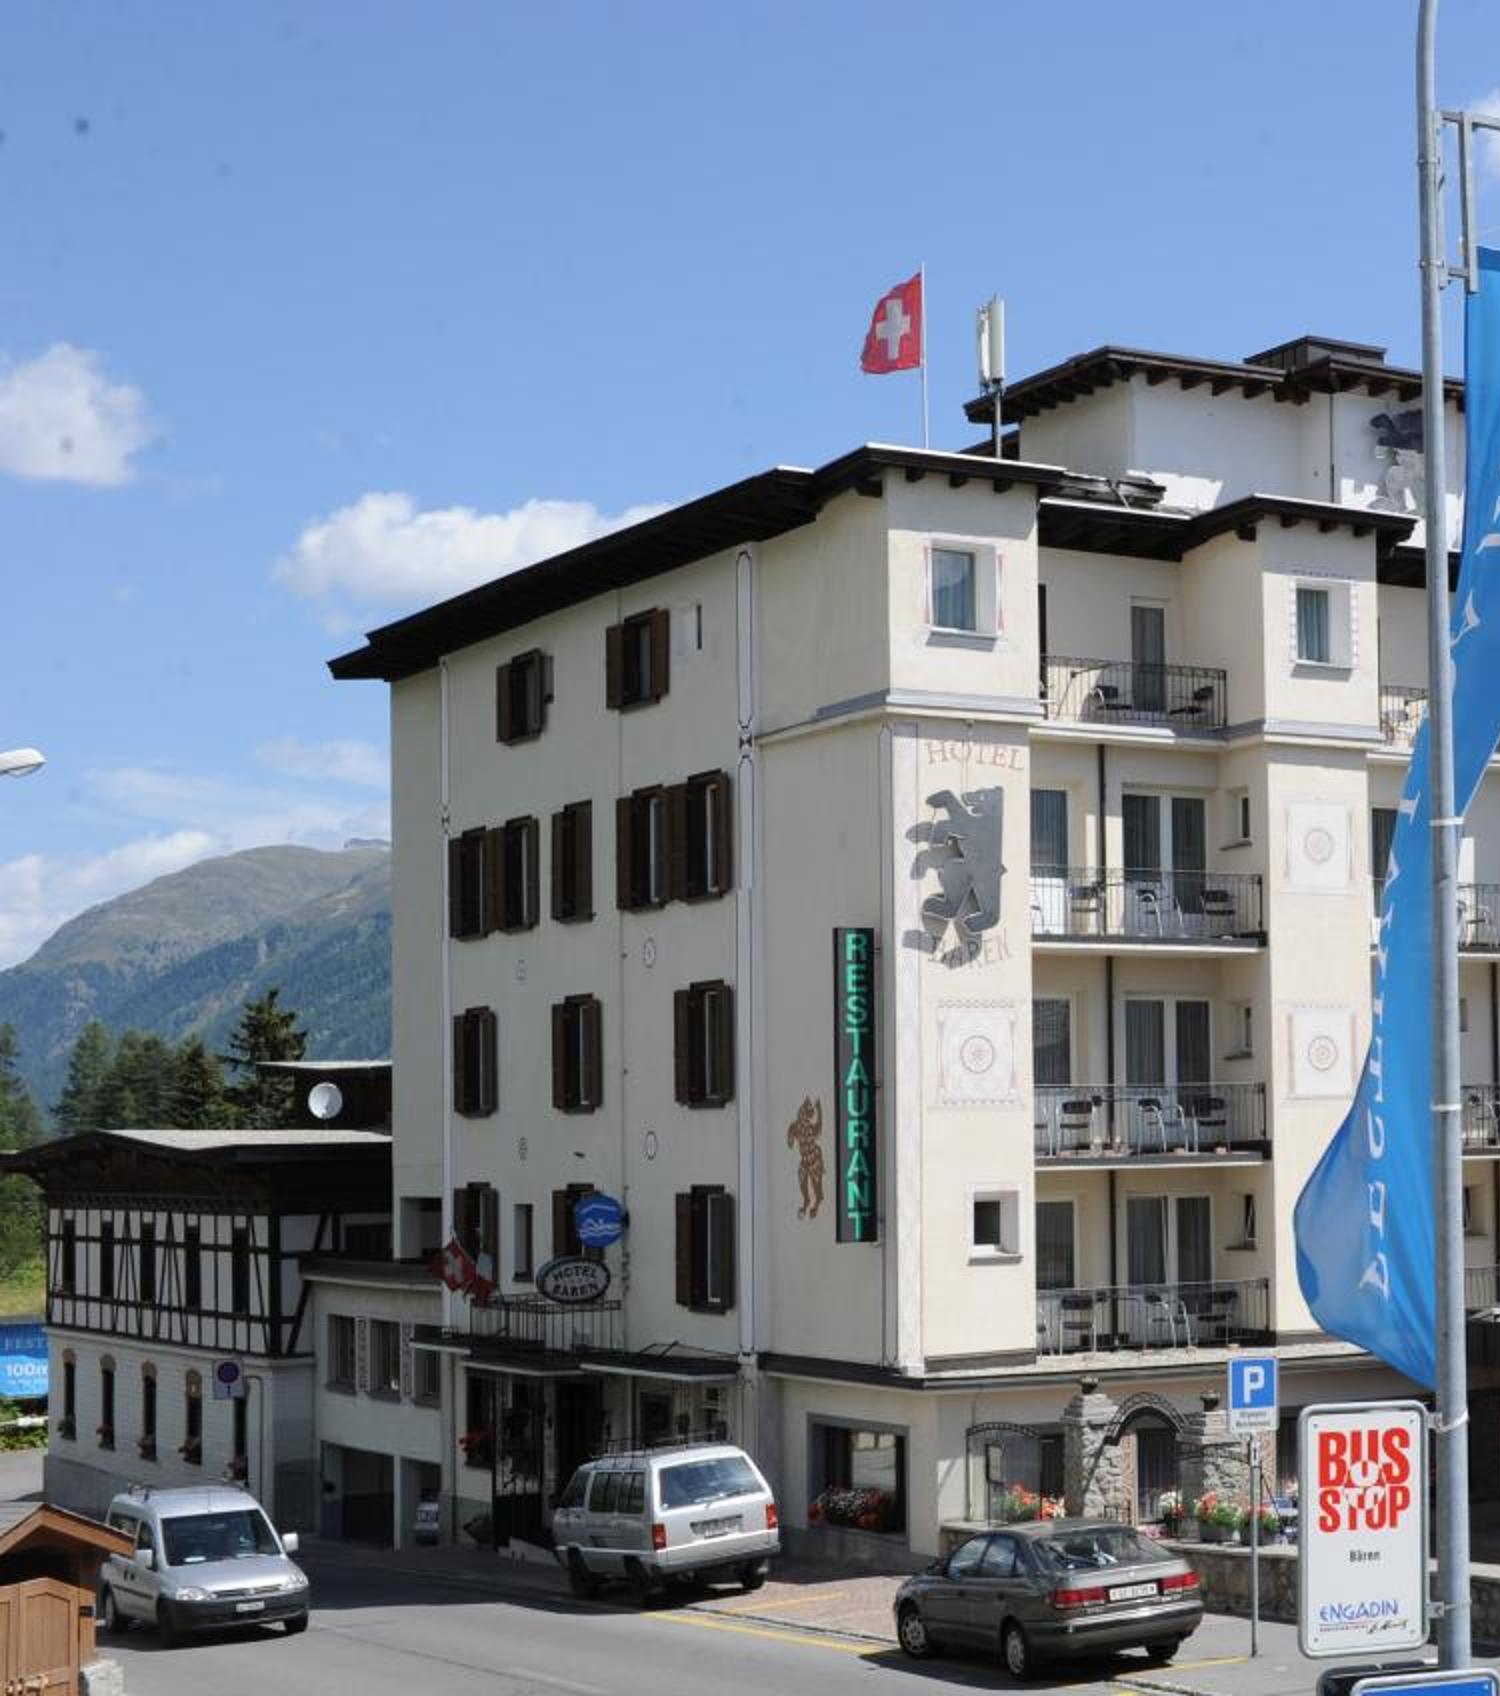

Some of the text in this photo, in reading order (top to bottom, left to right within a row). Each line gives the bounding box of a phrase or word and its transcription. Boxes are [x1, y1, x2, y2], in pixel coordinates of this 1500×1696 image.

[927, 741, 1025, 772] HOTEL
[844, 931, 869, 1241] RESTAURANT
[1318, 1427, 1411, 1488] BUS
[1318, 1485, 1411, 1533] STOP
